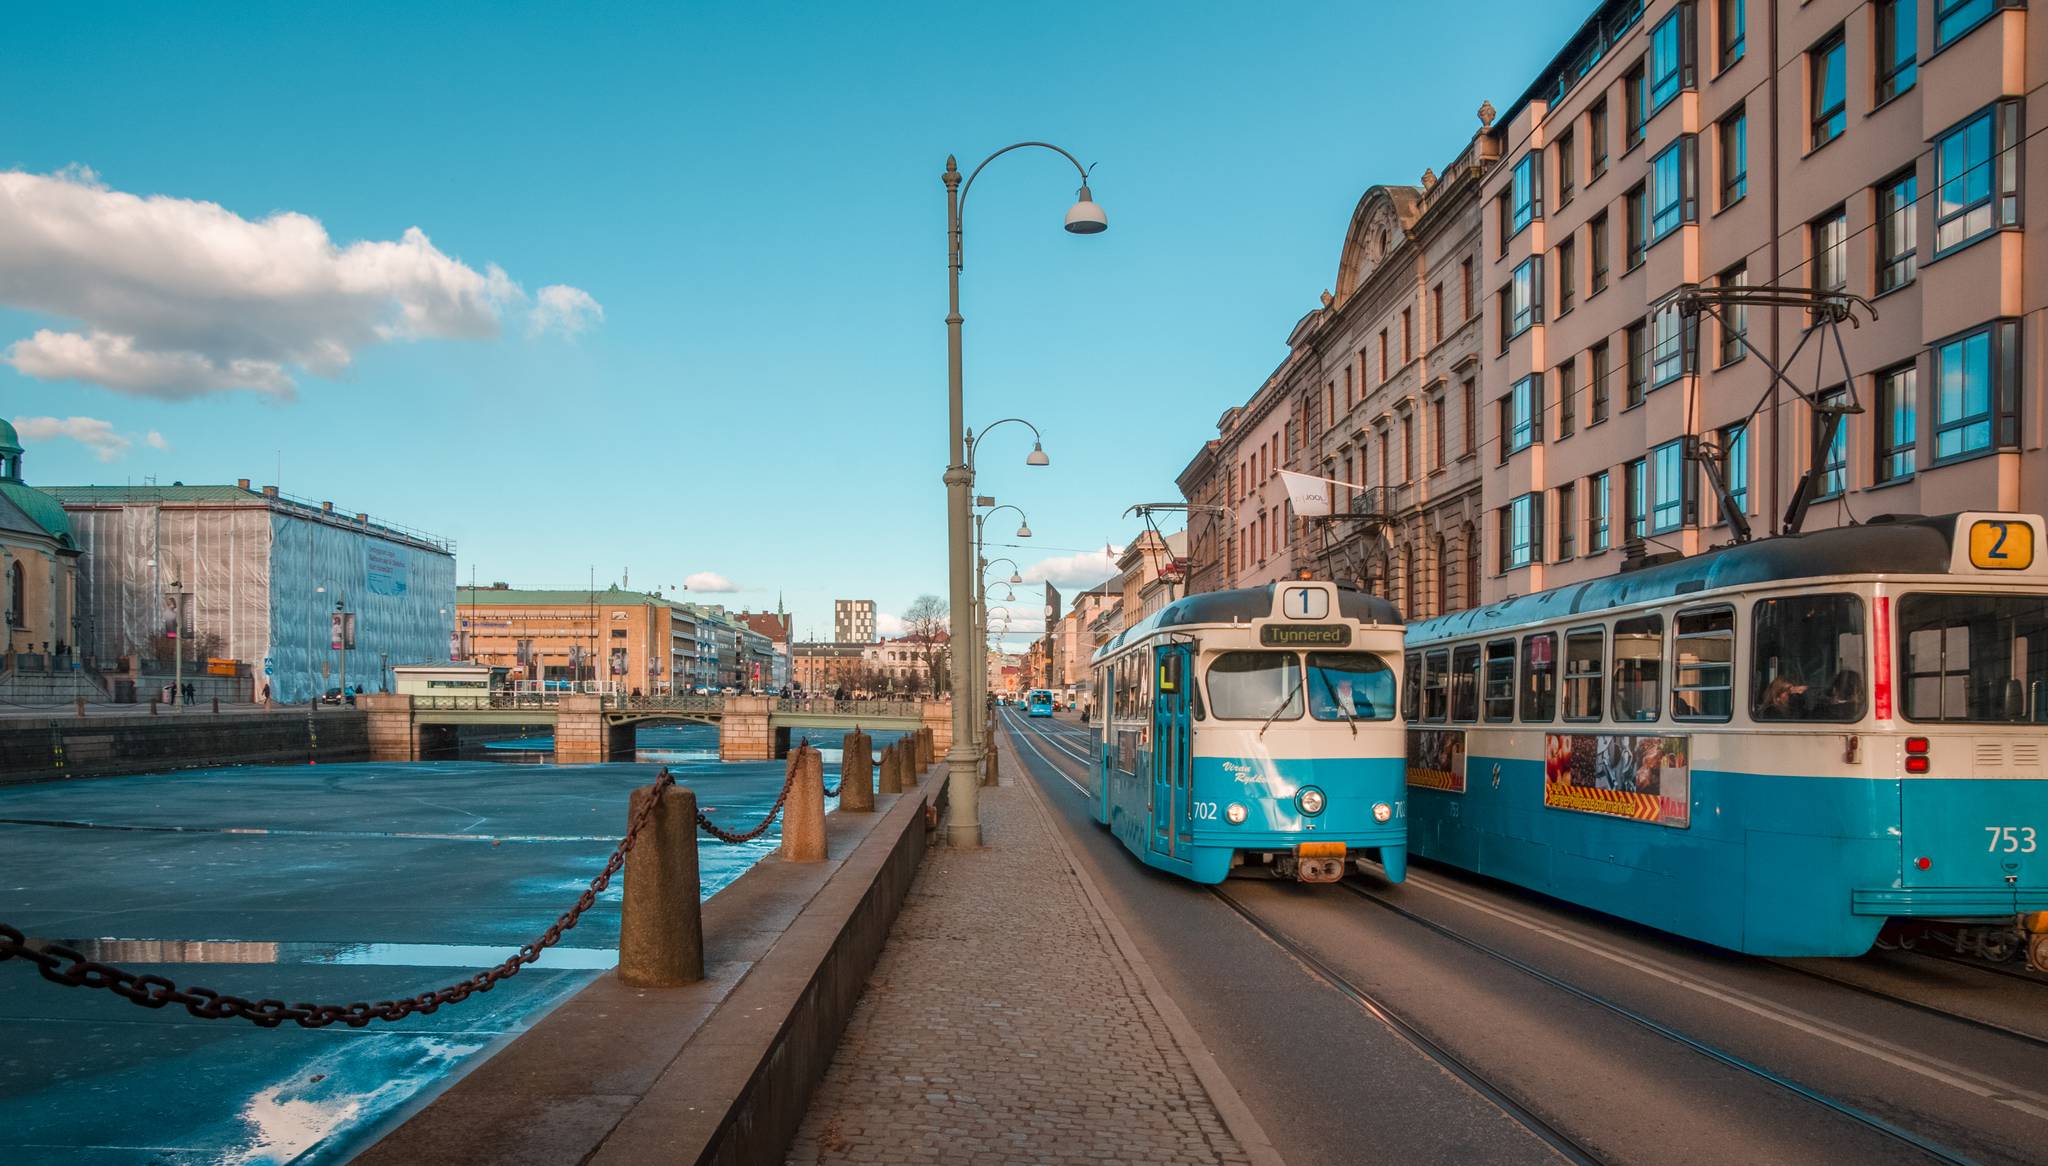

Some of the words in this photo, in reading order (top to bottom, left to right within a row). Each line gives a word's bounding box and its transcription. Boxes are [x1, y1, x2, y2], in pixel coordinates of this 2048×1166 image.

[1988, 521, 2008, 559] 2
[1298, 589, 1308, 614] 1
[1271, 627, 1340, 643] Tynnered
[1193, 802, 1217, 820] 702
[1984, 826, 2037, 853] 753
